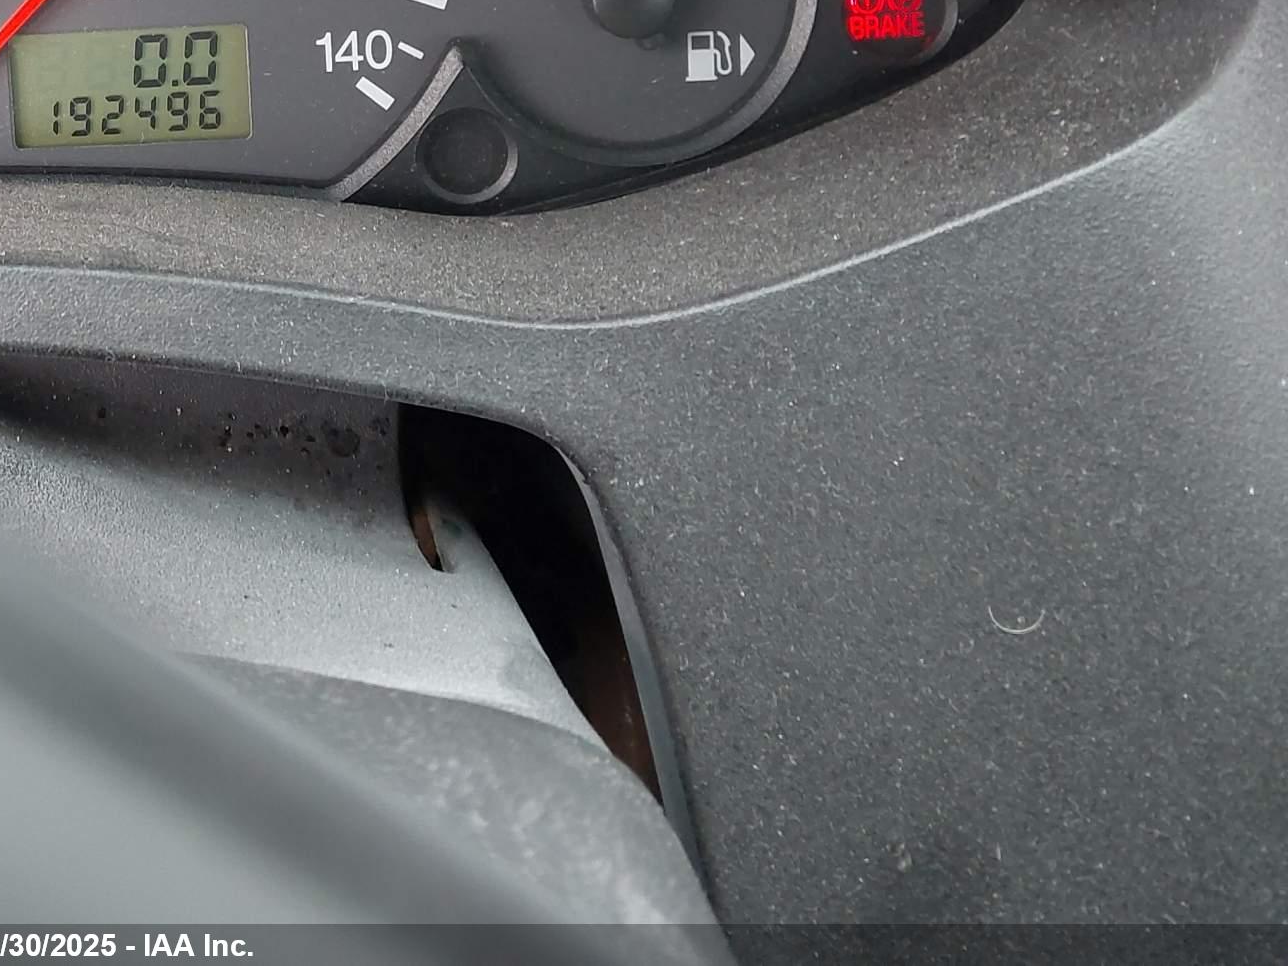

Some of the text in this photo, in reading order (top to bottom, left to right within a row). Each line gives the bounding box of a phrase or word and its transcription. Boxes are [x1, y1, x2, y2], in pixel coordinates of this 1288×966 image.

[847, 11, 925, 41] BRAKE
[133, 31, 218, 88] 0.0
[315, 29, 393, 73] 140
[52, 90, 221, 137] 192496
